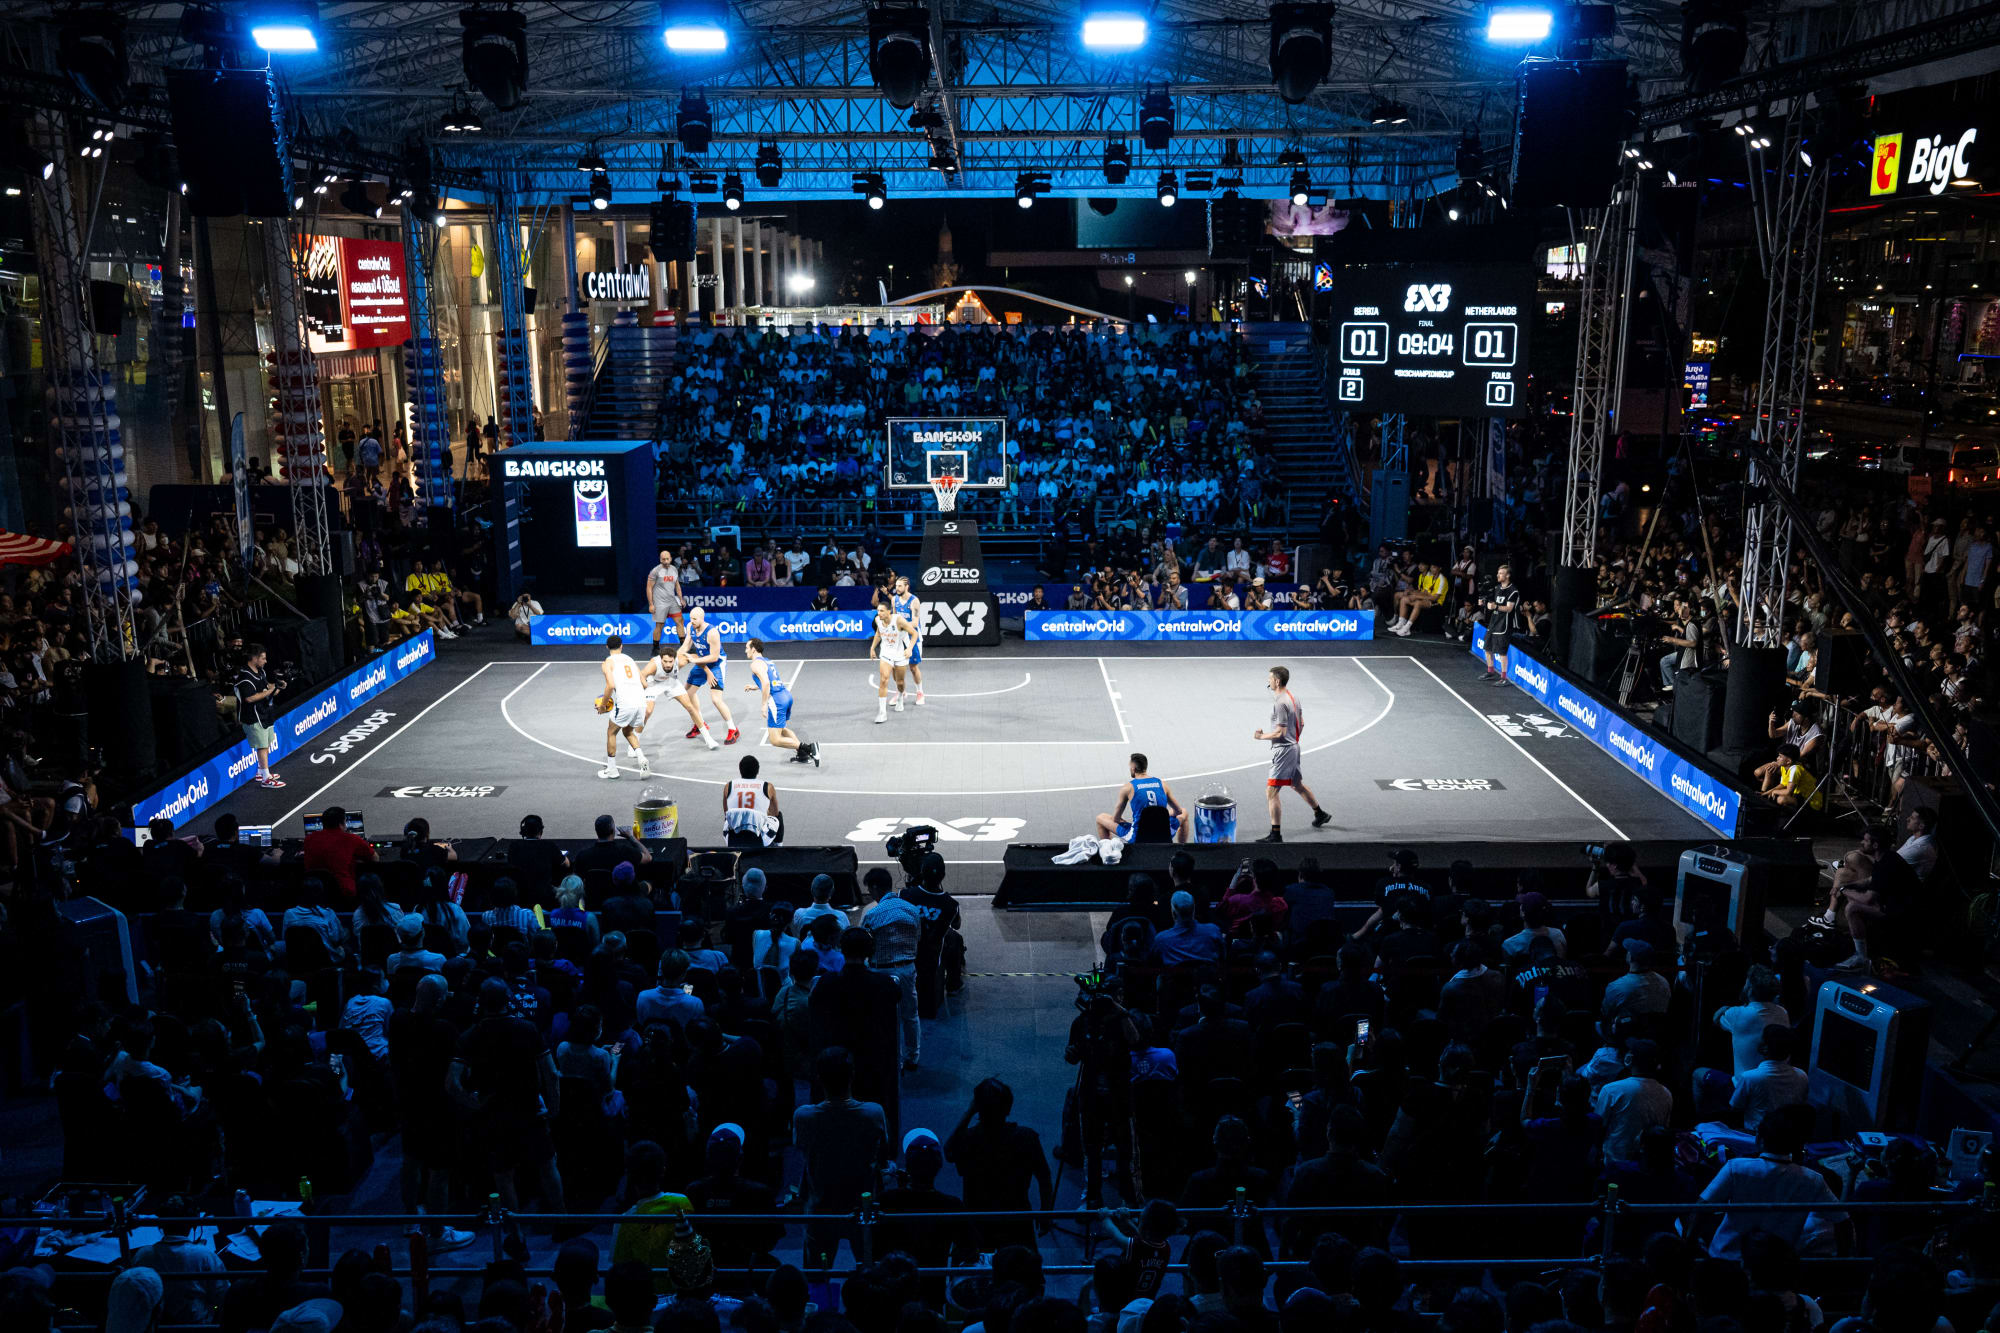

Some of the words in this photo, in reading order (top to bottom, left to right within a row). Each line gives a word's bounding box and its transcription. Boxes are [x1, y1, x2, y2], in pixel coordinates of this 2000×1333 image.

[1353, 307, 1379, 316] SERBIA
[1464, 306, 1517, 316] NETHERLANDS
[1350, 330, 1378, 356] 01
[1398, 333, 1453, 356] 09:04
[1474, 330, 1505, 358] 01
[1343, 368, 1361, 376] FOULS
[1491, 371, 1511, 380] FOULS
[1346, 381, 1356, 396] 2
[1495, 385, 1506, 402] 0
[912, 431, 983, 443] BANGKOK
[504, 460, 606, 477] BANGKOK
[941, 567, 980, 579] TERO
[547, 623, 631, 637] centralwOrld
[779, 619, 863, 634] centralwOrld
[1041, 619, 1125, 633] centralwOrld
[1157, 619, 1241, 633] centralwOrld
[1273, 619, 1357, 633] centralwOrld
[396, 640, 429, 671] centralwOrld
[350, 665, 386, 700] centralwOrld
[1514, 663, 1548, 695] centralwOrld
[294, 696, 337, 737] centralwOrld
[1558, 694, 1597, 730] centralwOrld
[1609, 730, 1655, 772] centralwOrld
[737, 791, 755, 809] 13
[1671, 773, 1727, 821] centralwOrld
